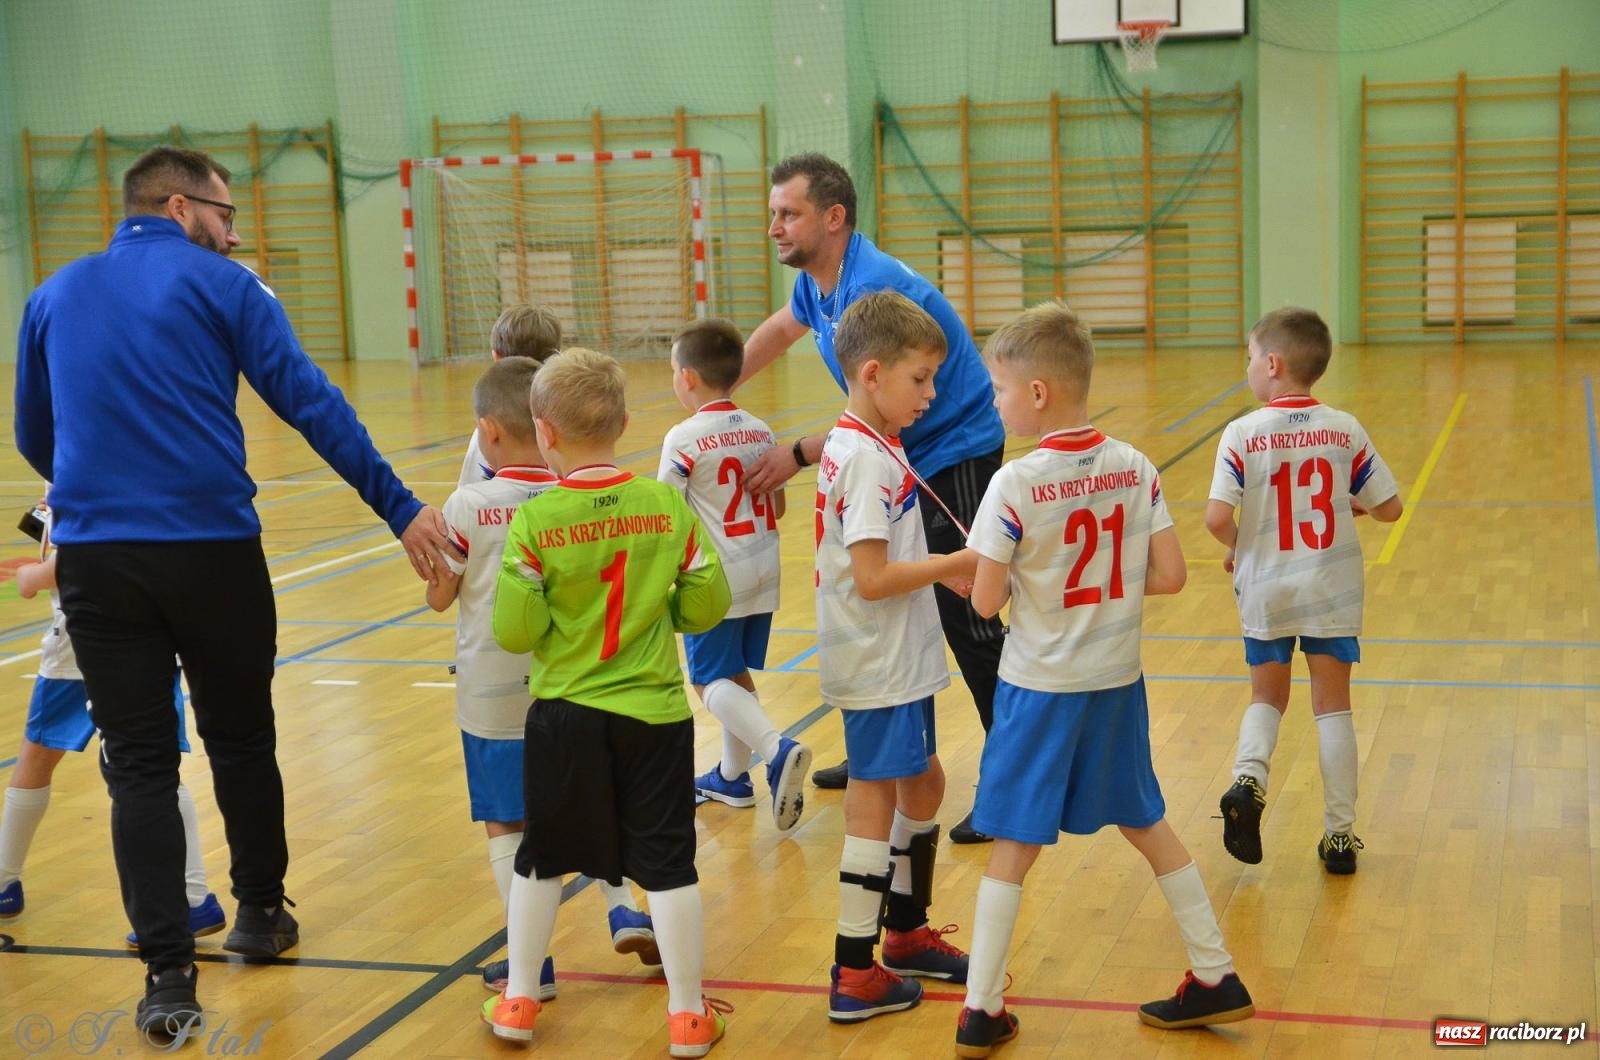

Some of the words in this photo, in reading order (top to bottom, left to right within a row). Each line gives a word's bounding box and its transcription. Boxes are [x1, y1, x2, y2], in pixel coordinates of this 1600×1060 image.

[1288, 413, 1310, 424] 1920
[696, 435, 719, 453] LKS
[1246, 435, 1268, 453] LKS
[1270, 428, 1351, 450] KRZYŻANOWICE
[1078, 456, 1095, 467] 1920
[1031, 483, 1057, 504] LKS
[1059, 469, 1140, 499] KRZYŻANOWICE
[592, 495, 619, 509] 1920
[1270, 457, 1335, 551] 13
[477, 507, 502, 526] LKS
[538, 527, 566, 550] LKS
[569, 514, 673, 545] KRZYŻANOWICE
[1063, 503, 1124, 609] 21
[599, 549, 629, 661] 1
